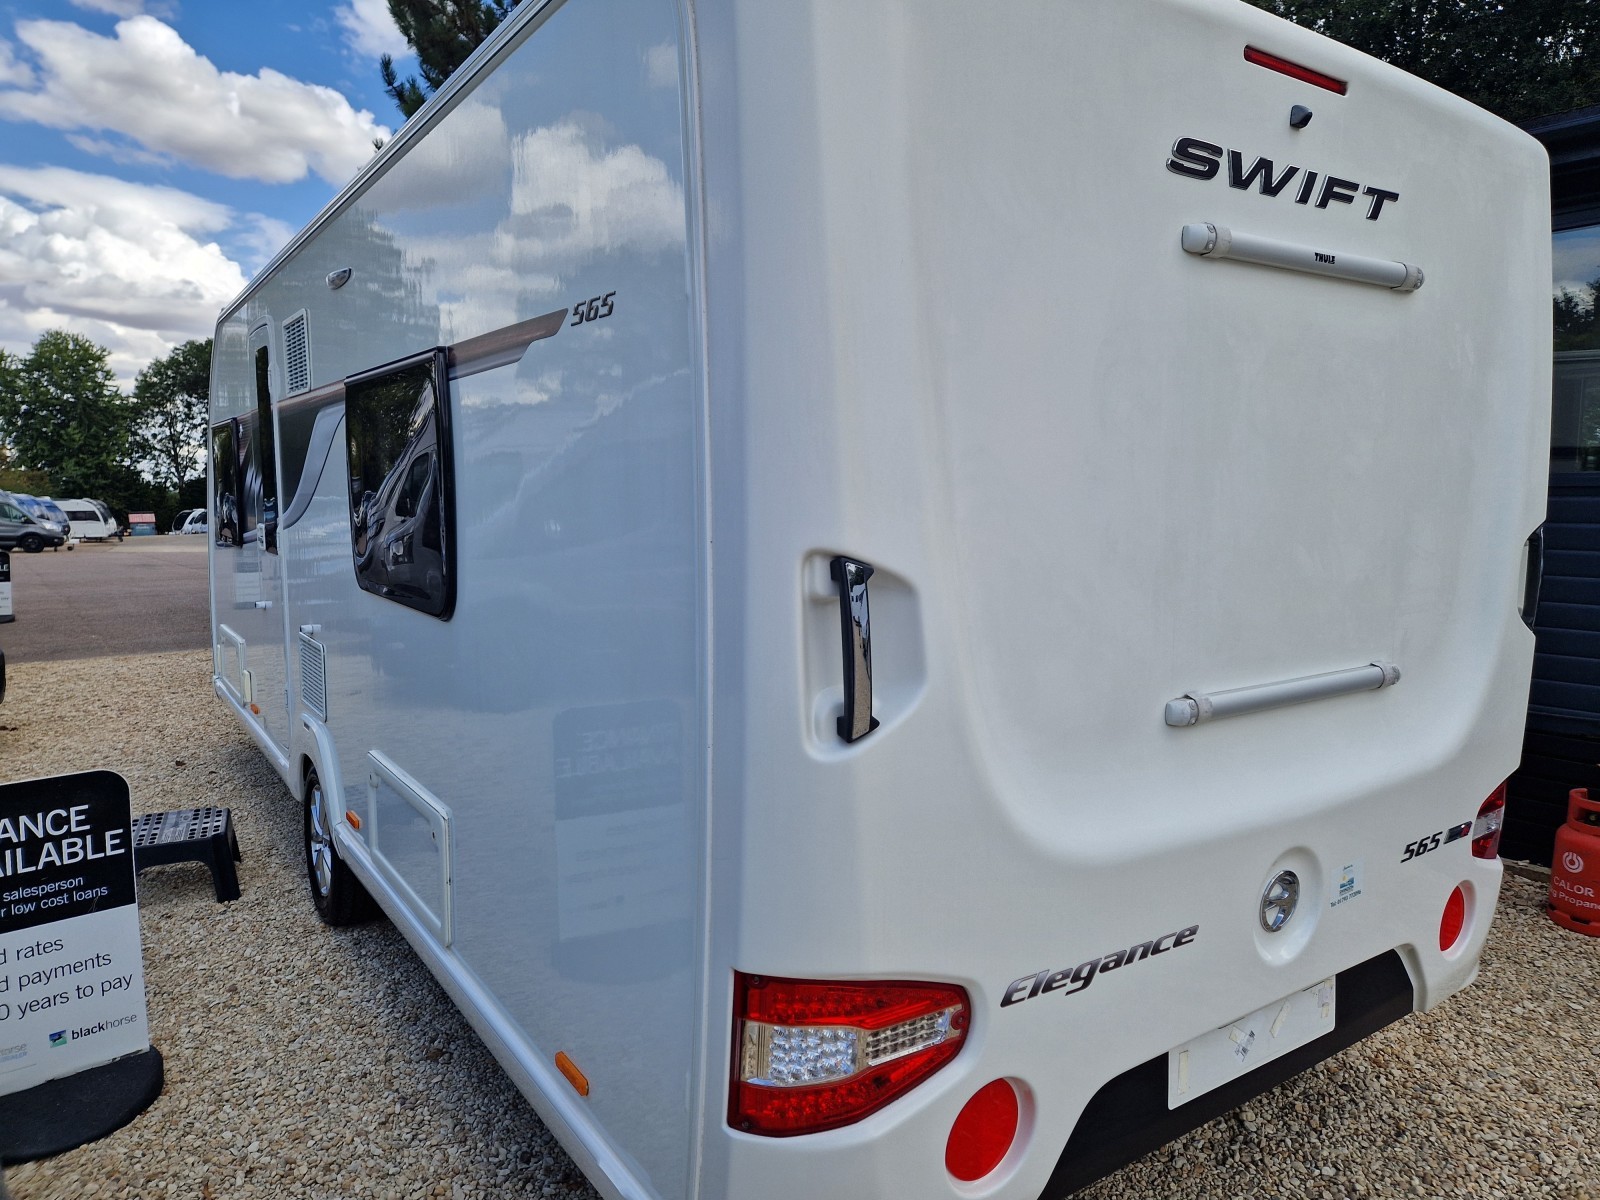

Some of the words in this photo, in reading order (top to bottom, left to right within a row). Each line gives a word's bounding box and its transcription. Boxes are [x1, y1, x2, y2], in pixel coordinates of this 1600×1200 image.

[1166, 136, 1399, 221] SWIFT
[1314, 252, 1335, 264] THULE
[571, 291, 616, 326] 565
[0, 804, 91, 843] ANCE
[1400, 831, 1443, 863] 565
[3, 877, 84, 902] salesperson
[12, 902, 36, 916] low
[40, 893, 69, 909] cost
[73, 886, 108, 902] loans
[1554, 876, 1594, 897] CALOR
[16, 938, 64, 960] rates
[18, 952, 112, 992] payments
[1000, 924, 1199, 1008] Elegance
[18, 991, 70, 1020] years
[76, 984, 94, 1000] to
[101, 974, 132, 996] pay
[71, 1014, 138, 1041] blackhorse
